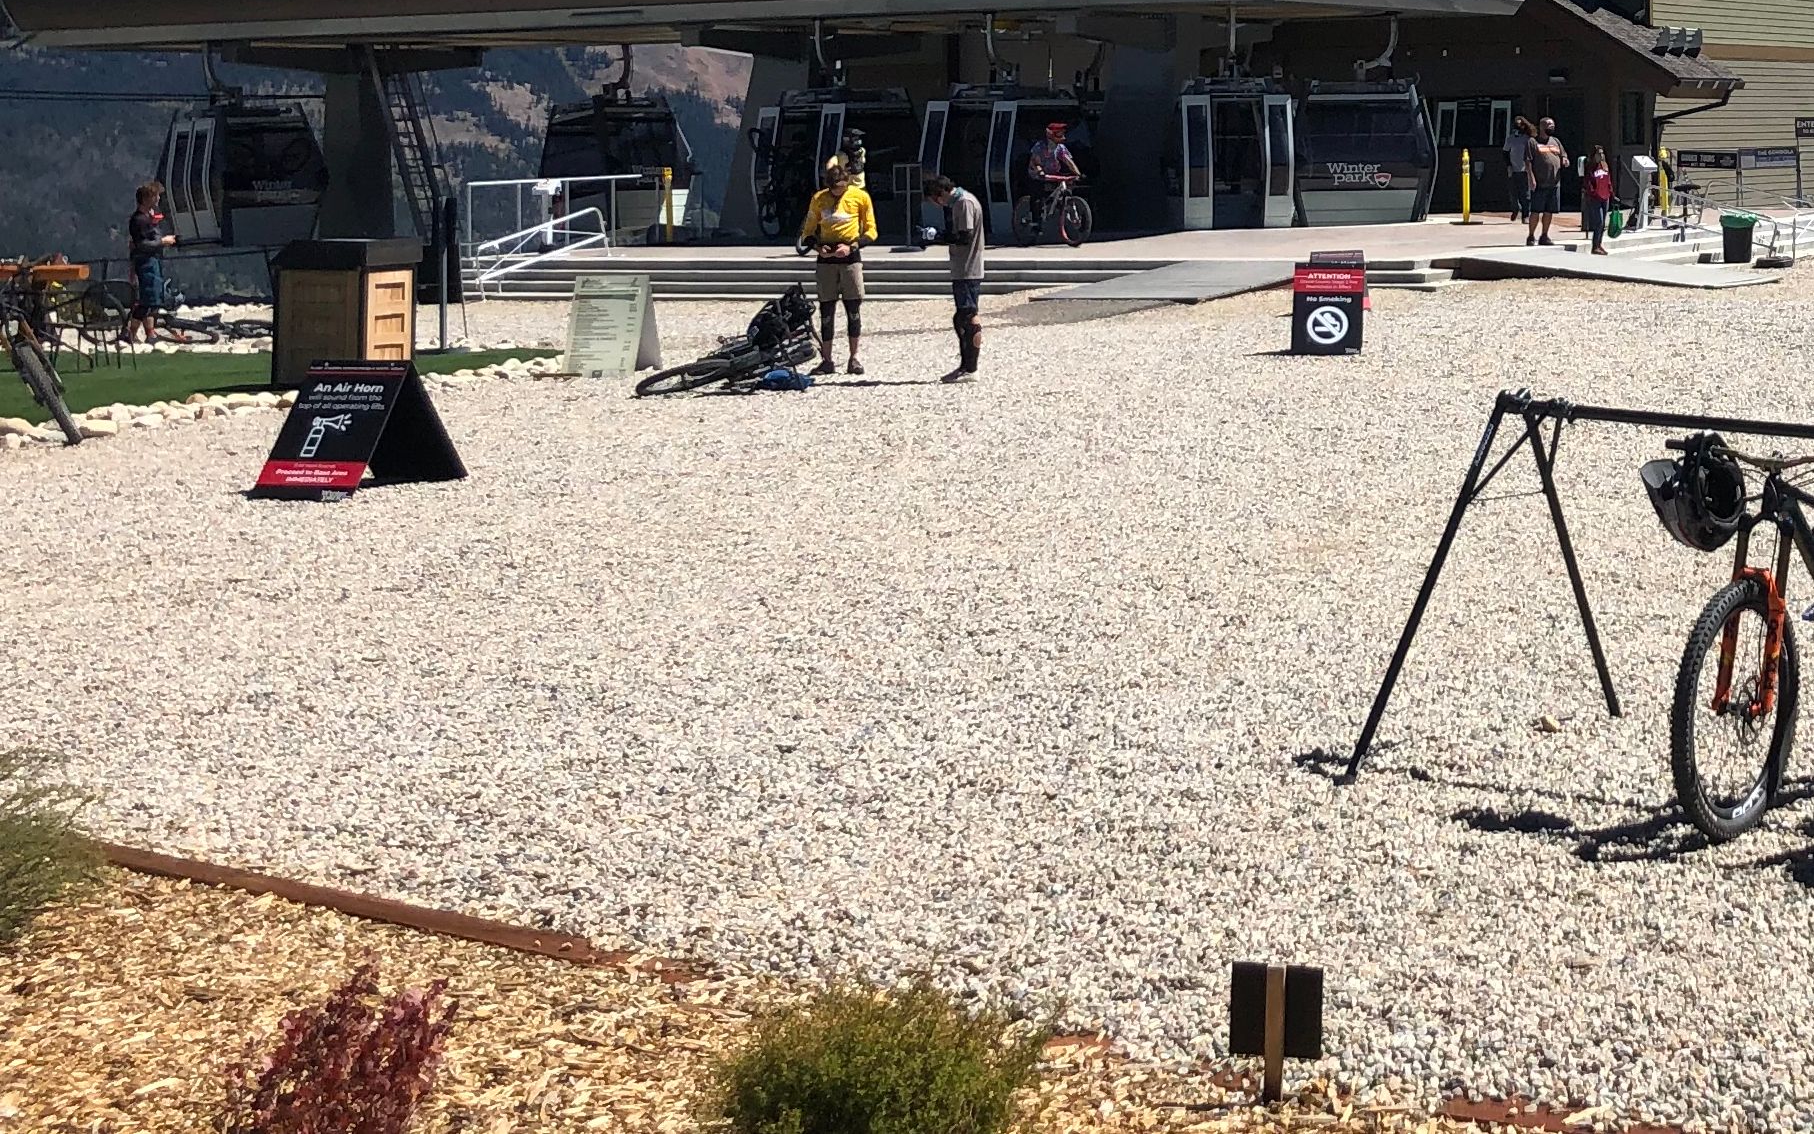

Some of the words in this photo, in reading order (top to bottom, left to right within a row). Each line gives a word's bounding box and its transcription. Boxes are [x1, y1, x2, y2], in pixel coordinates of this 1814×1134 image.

[1326, 162, 1381, 174] Winter
[1333, 171, 1376, 186] park
[1307, 272, 1351, 280] ATTENTION
[313, 382, 332, 393] An
[333, 382, 352, 393] Air
[353, 383, 384, 393] Horn
[298, 402, 312, 410] top
